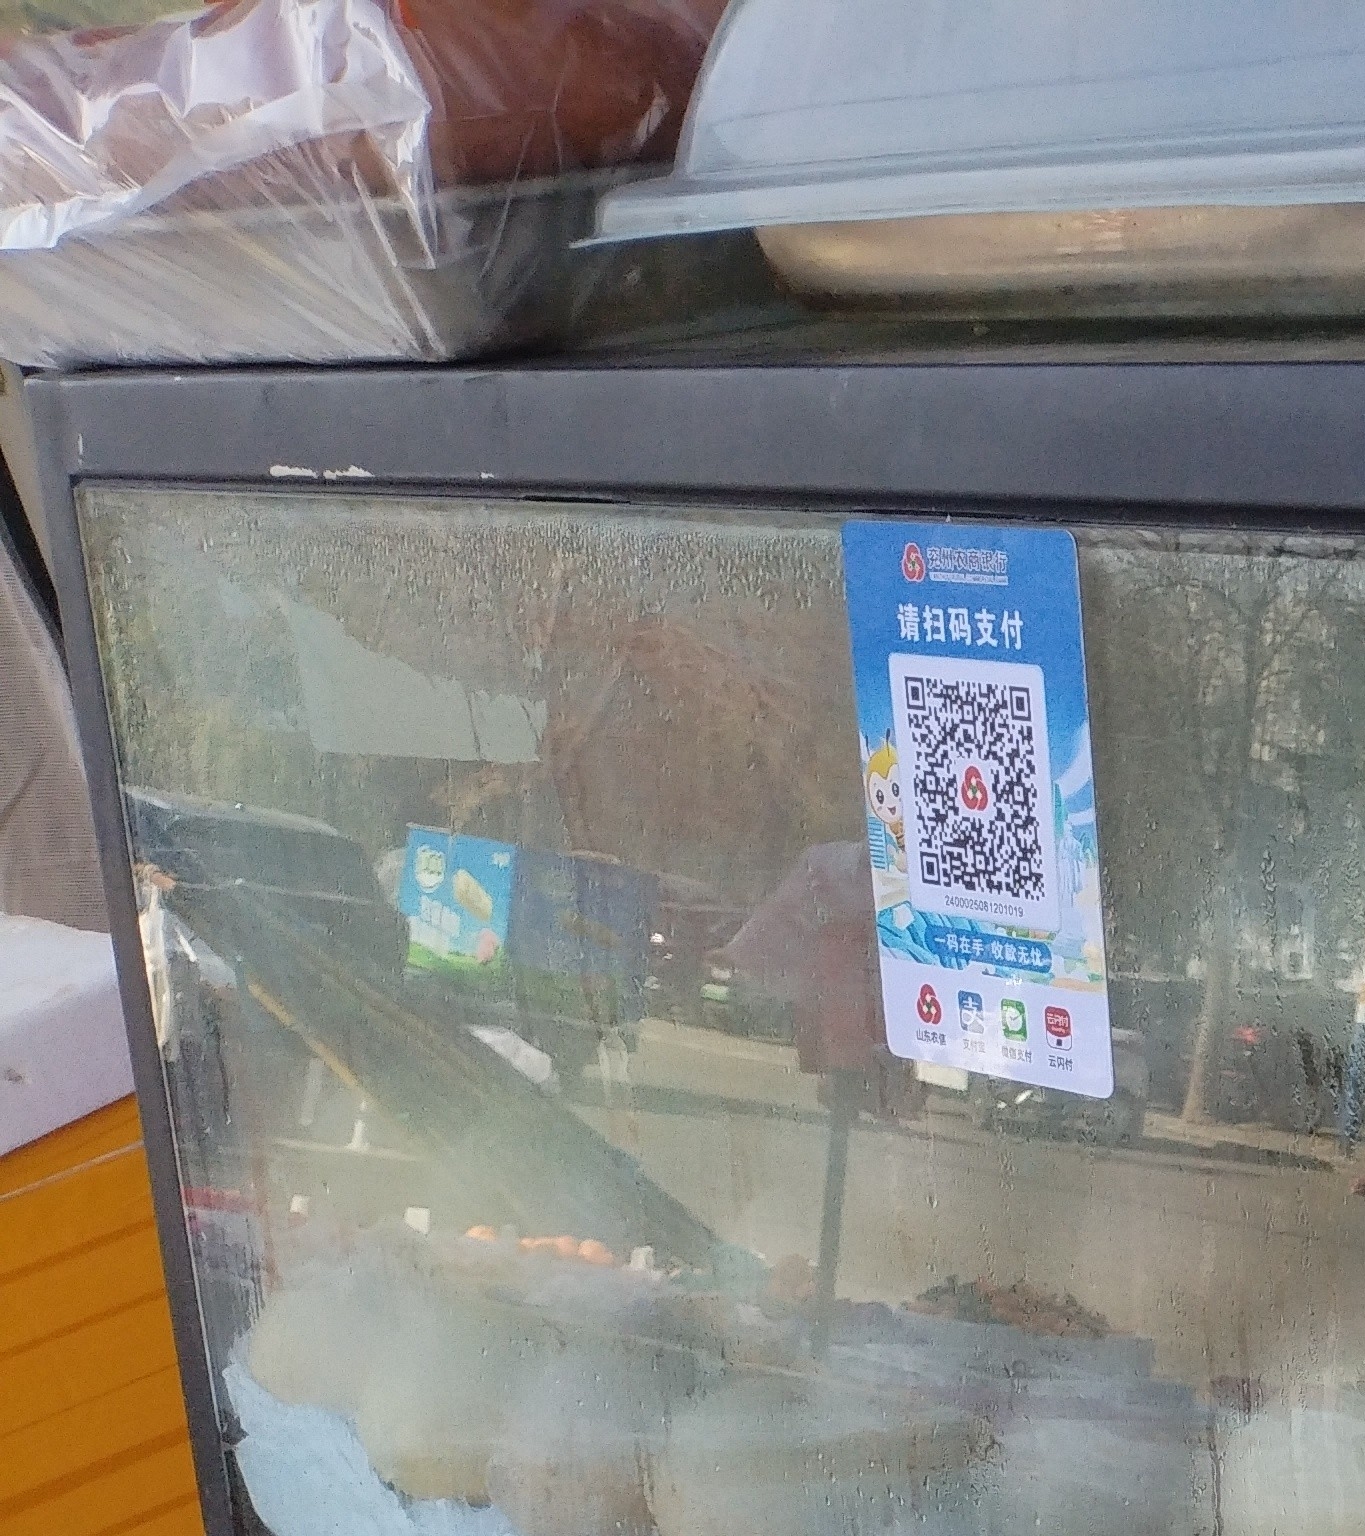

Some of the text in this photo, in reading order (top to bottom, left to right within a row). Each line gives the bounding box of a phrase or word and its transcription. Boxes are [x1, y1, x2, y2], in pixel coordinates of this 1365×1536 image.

[897, 602, 1024, 650] 请扫码支付
[934, 933, 985, 957] 一码在手
